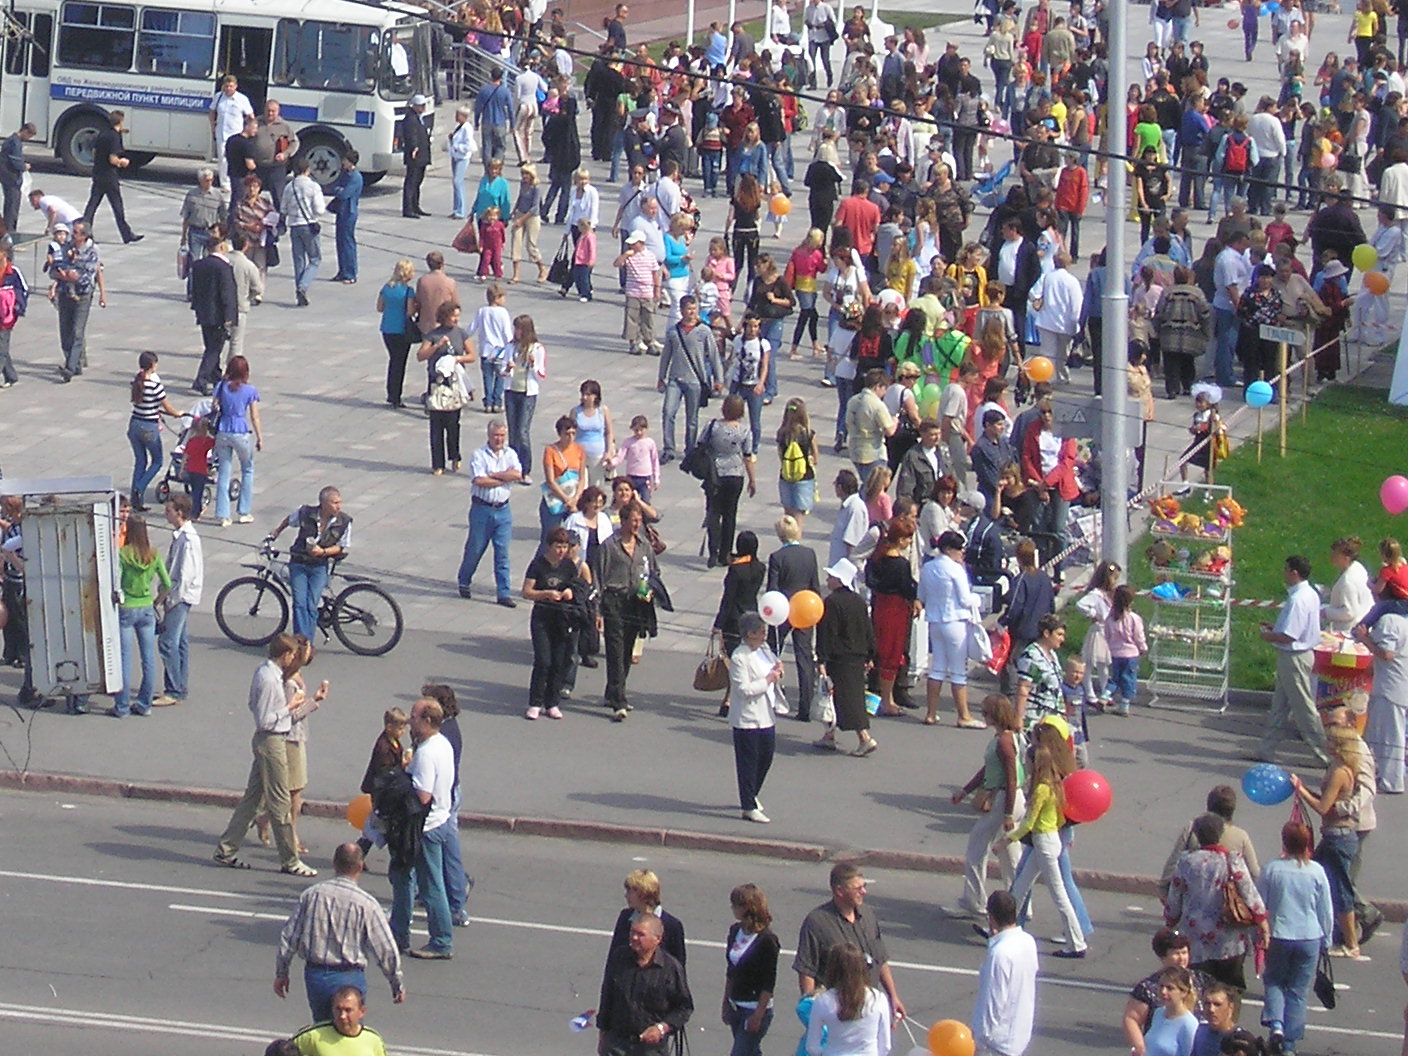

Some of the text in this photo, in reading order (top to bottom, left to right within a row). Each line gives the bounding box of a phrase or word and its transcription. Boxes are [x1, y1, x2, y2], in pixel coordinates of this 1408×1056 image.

[65, 87, 204, 108] ПЕРЕДВИЖНОЙ ПУНКТ МИЛИЦИИ
